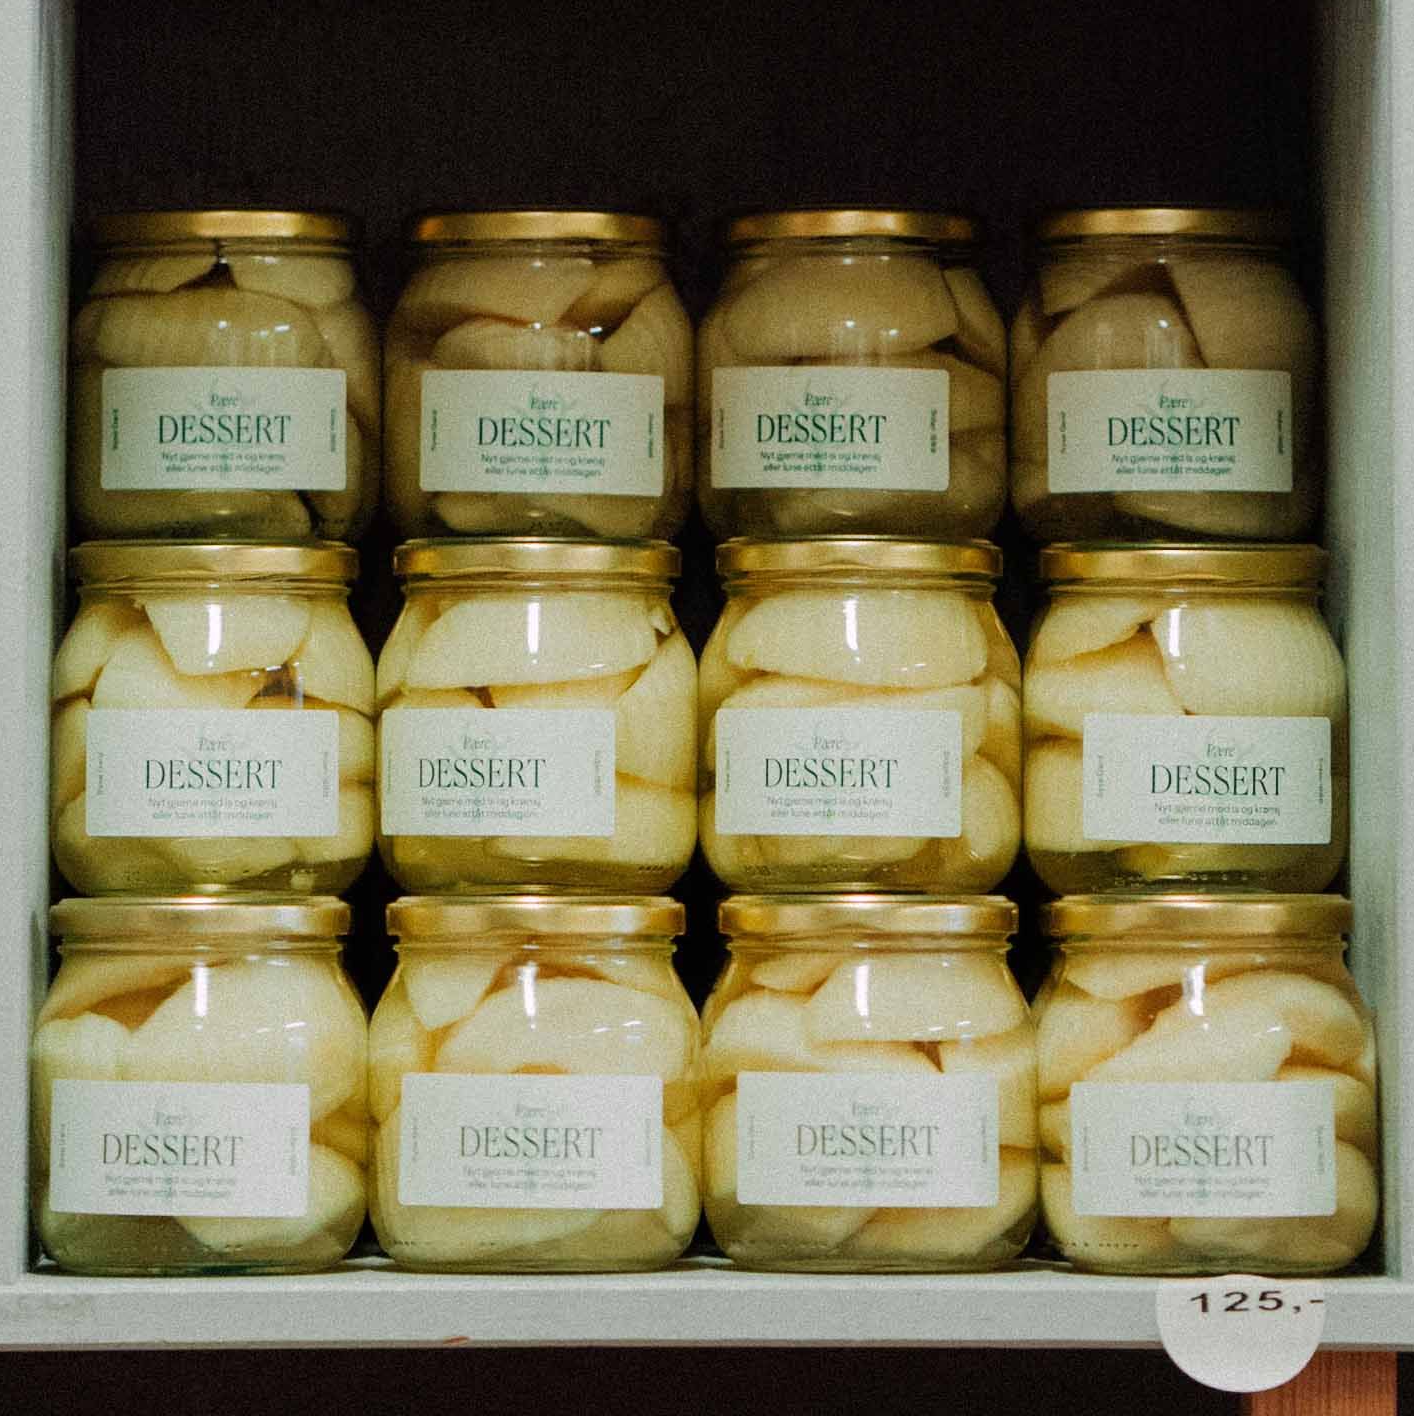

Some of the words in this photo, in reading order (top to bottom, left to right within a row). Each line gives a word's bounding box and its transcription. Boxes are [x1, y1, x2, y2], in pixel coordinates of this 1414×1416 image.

[158, 414, 291, 444] DESSERT
[477, 416, 611, 448] DESSERT
[756, 414, 887, 444] DESSERT
[1108, 417, 1240, 446] DESSERT
[145, 759, 283, 790] DESSERT
[418, 758, 547, 788] DESSERT
[764, 758, 899, 788] DESSERT
[1150, 764, 1286, 796] DESSERT
[102, 1134, 243, 1166] DESSERT
[459, 1125, 602, 1159] DESSERT
[795, 1124, 939, 1158] DESSERT
[1131, 1135, 1274, 1167] DESSERT
[1190, 1290, 1324, 1314] 125,-
